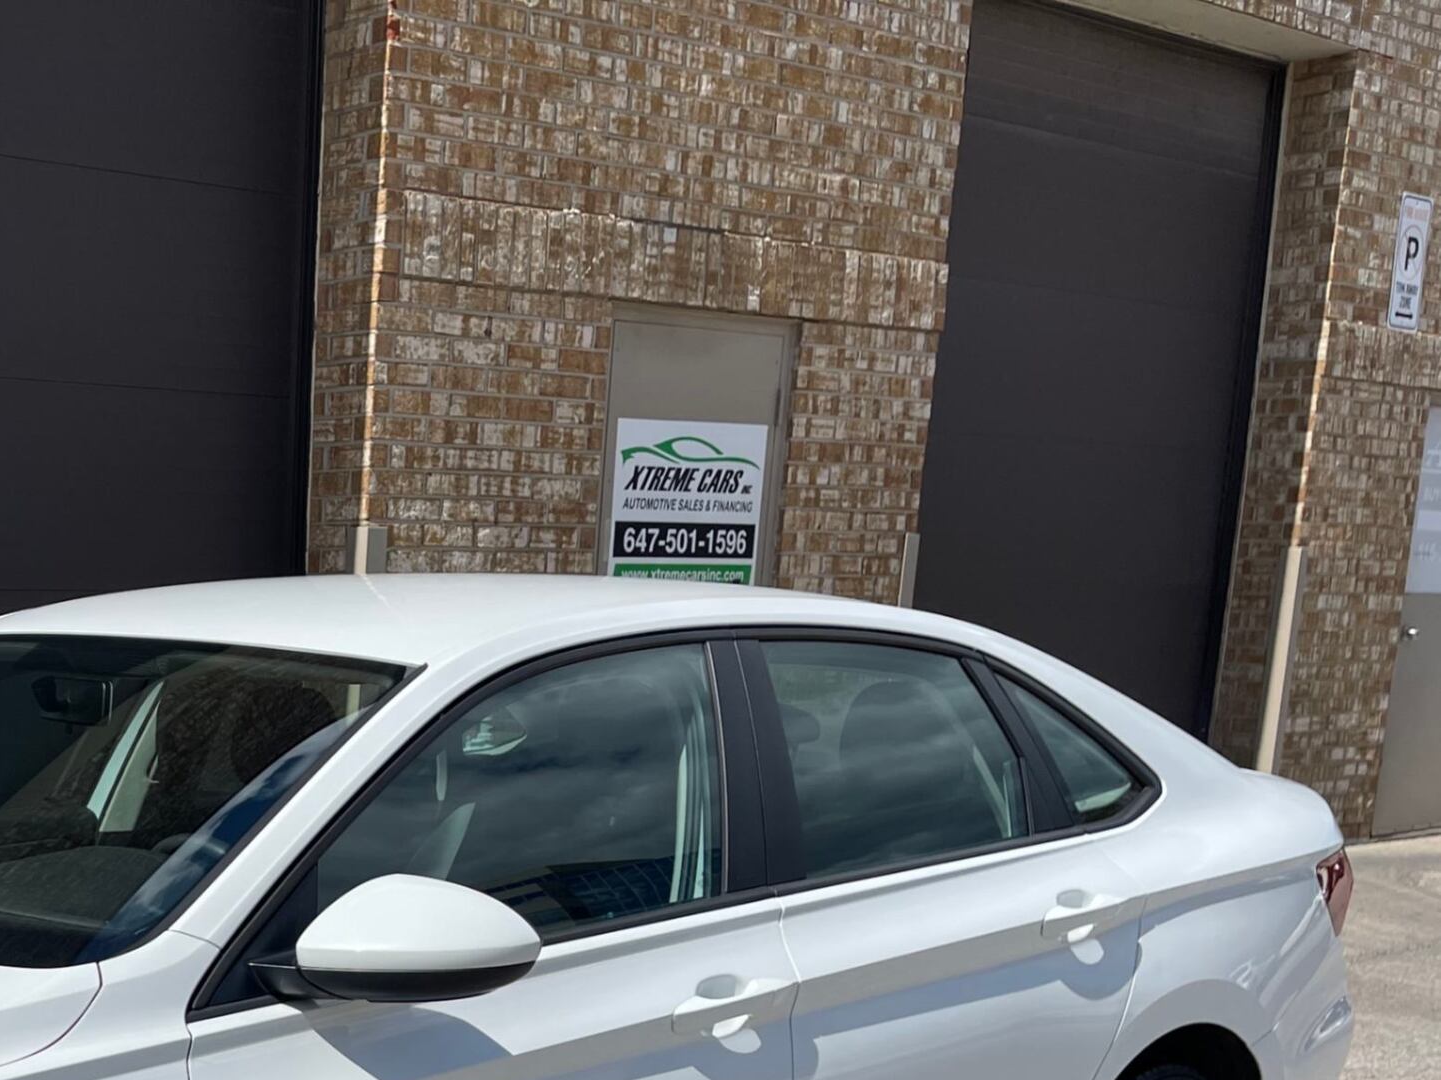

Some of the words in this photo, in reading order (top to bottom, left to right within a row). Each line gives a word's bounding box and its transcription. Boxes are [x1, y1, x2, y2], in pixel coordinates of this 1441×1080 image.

[625, 465, 699, 493] XTREME
[697, 468, 744, 495] CARS
[623, 497, 676, 512] AUTOMOTIVE
[678, 499, 704, 512] SALES
[713, 501, 753, 513] FINANCING
[623, 527, 747, 554] 647-501-1596
[621, 568, 744, 582] wwwxtremecarsinc.com
